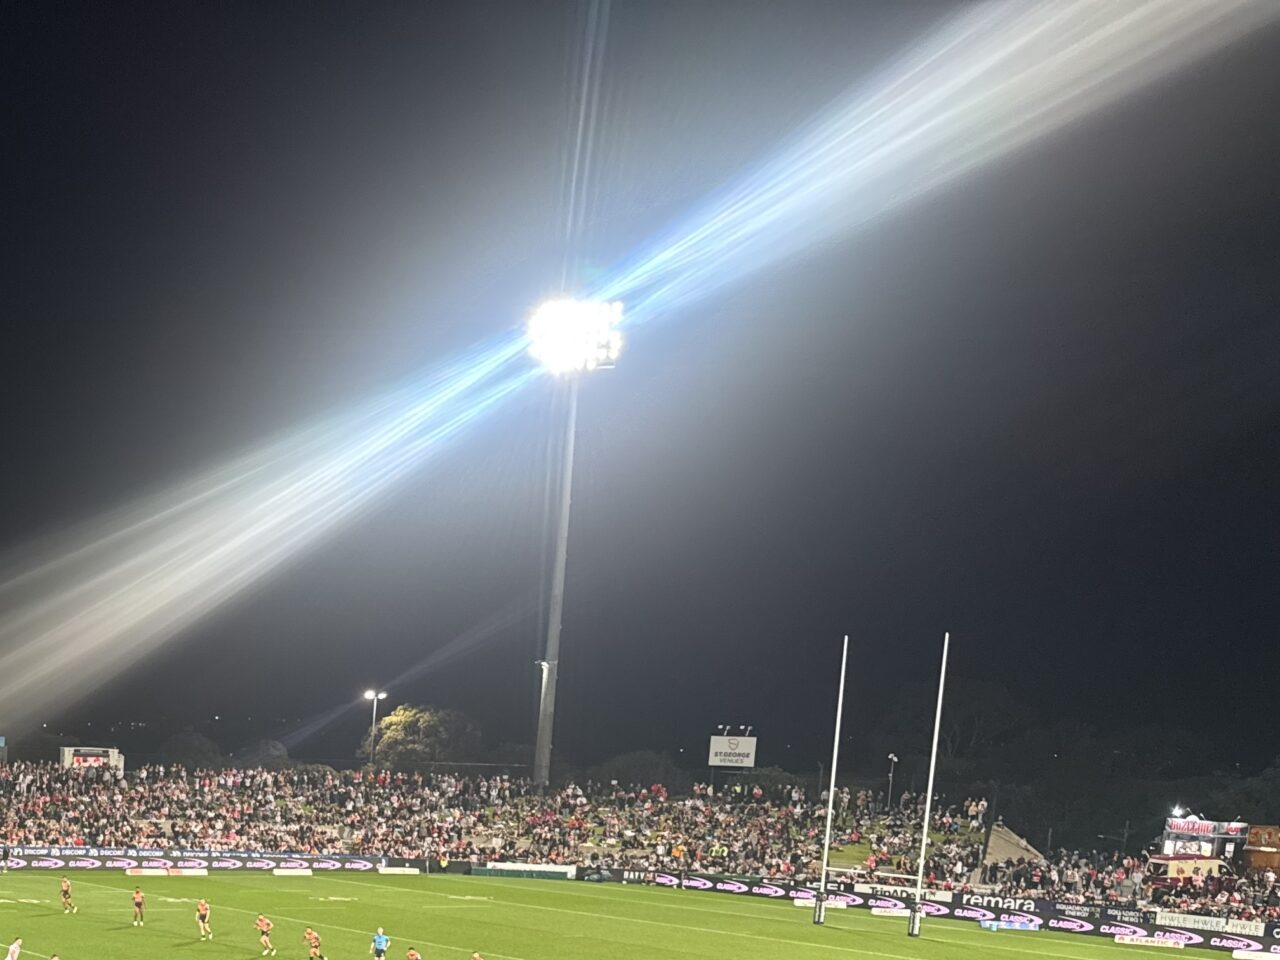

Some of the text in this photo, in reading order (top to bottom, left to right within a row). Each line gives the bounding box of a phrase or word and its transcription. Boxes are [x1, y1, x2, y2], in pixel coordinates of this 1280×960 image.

[869, 886, 926, 900] TripADel
[1056, 904, 1090, 912] SQUADRON
[954, 909, 983, 918] CLASSIC
[1065, 910, 1089, 918] ENERGY
[1000, 914, 1030, 924] CLASSIC
[1160, 915, 1187, 924] HWLE
[1193, 919, 1220, 927] HWLE
[1048, 919, 1081, 930] CLASSIC
[1232, 922, 1260, 932] HWLE
[1100, 924, 1134, 936] CLASSIC
[1154, 930, 1190, 942] CLASSIC
[1128, 938, 1170, 946] ATLANTIC
[1210, 937, 1248, 949] CLASSIC
